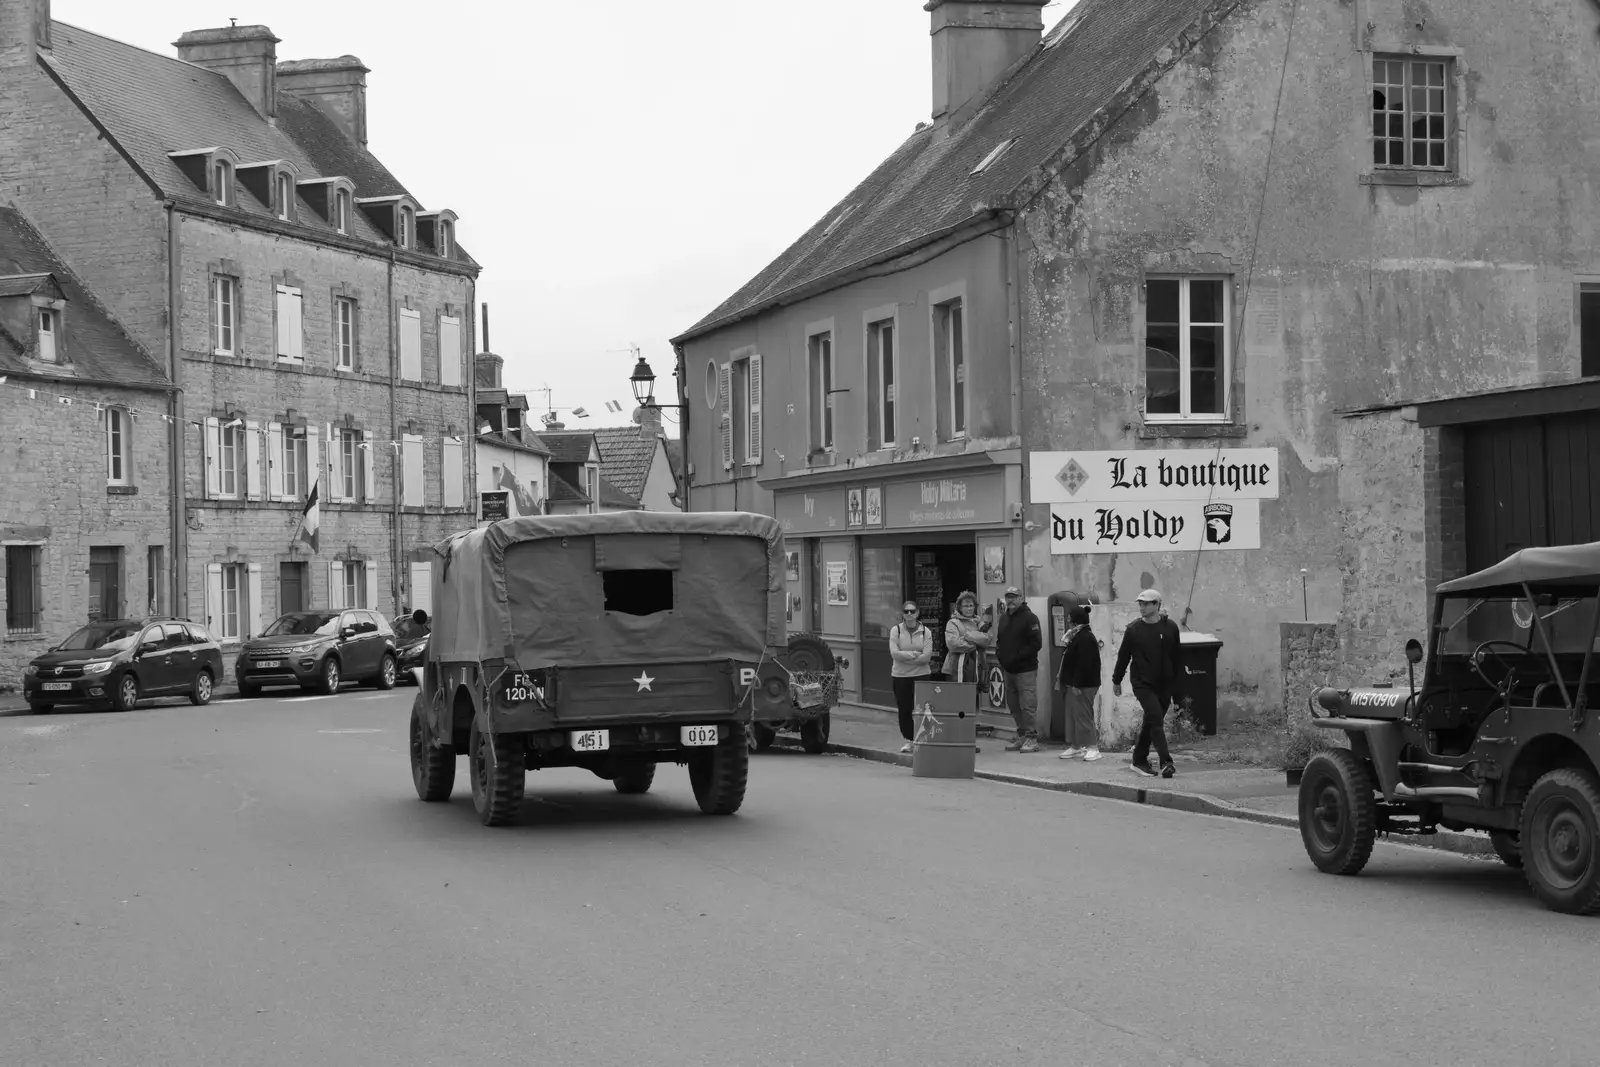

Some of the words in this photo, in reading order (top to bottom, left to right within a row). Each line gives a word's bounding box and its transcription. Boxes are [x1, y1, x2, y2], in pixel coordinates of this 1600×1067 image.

[1107, 457, 1148, 489] La
[1157, 456, 1270, 492] boutique
[1051, 512, 1085, 541] du
[1094, 508, 1185, 546] Holdy
[1350, 692, 1399, 708] M1570910
[688, 729, 716, 743] 002
